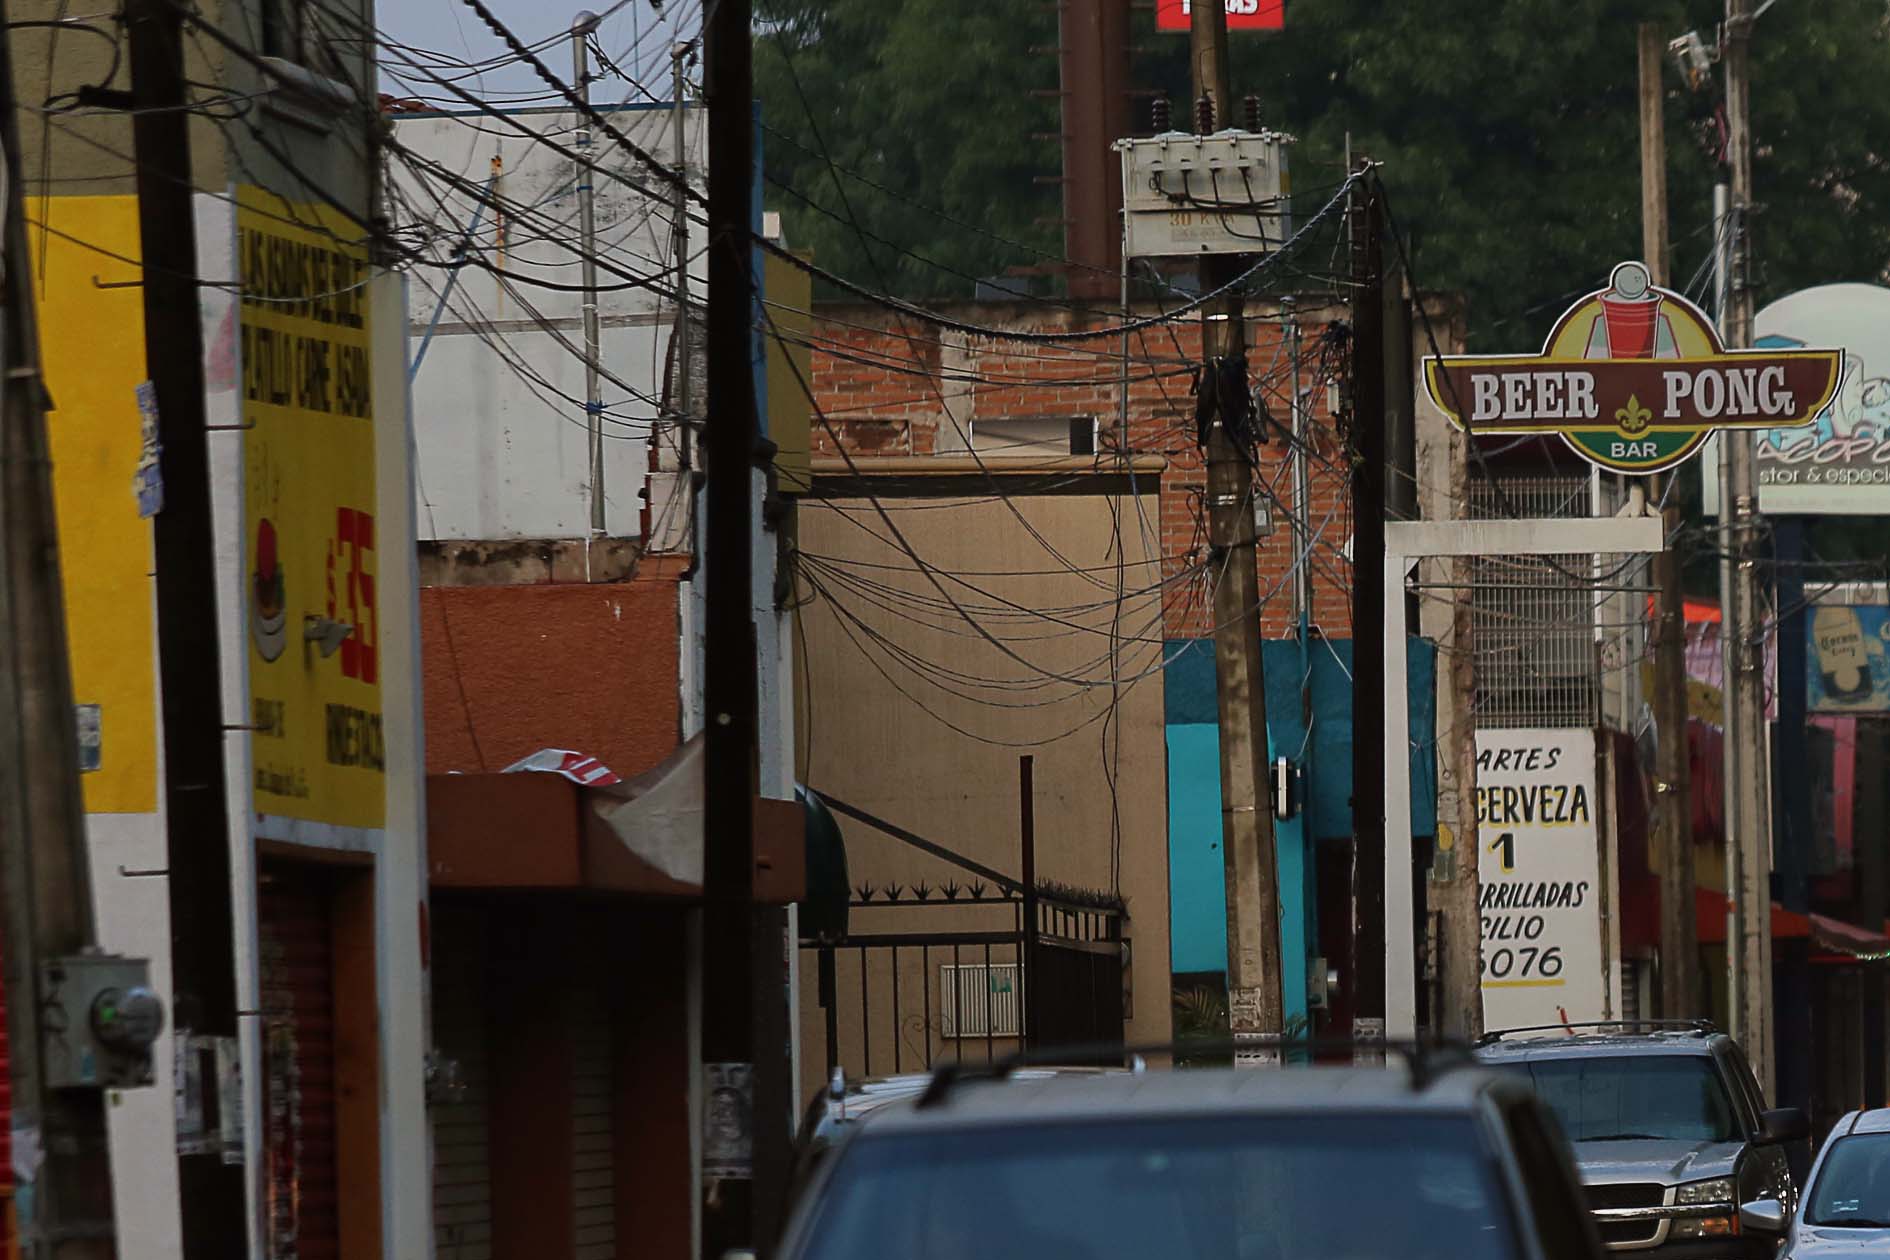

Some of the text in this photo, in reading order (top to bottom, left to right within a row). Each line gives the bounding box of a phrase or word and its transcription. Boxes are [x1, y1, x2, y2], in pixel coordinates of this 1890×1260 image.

[1470, 365, 1796, 421] BEER PONG
[1610, 442, 1658, 458] BAR
[1759, 466, 1800, 483] stor
[1477, 747, 1562, 771] ARTES
[1475, 784, 1590, 824] CERVEZA
[1491, 832, 1515, 869] 1
[1480, 881, 1589, 909] RRILLADAS
[1480, 915, 1545, 940] CILIO
